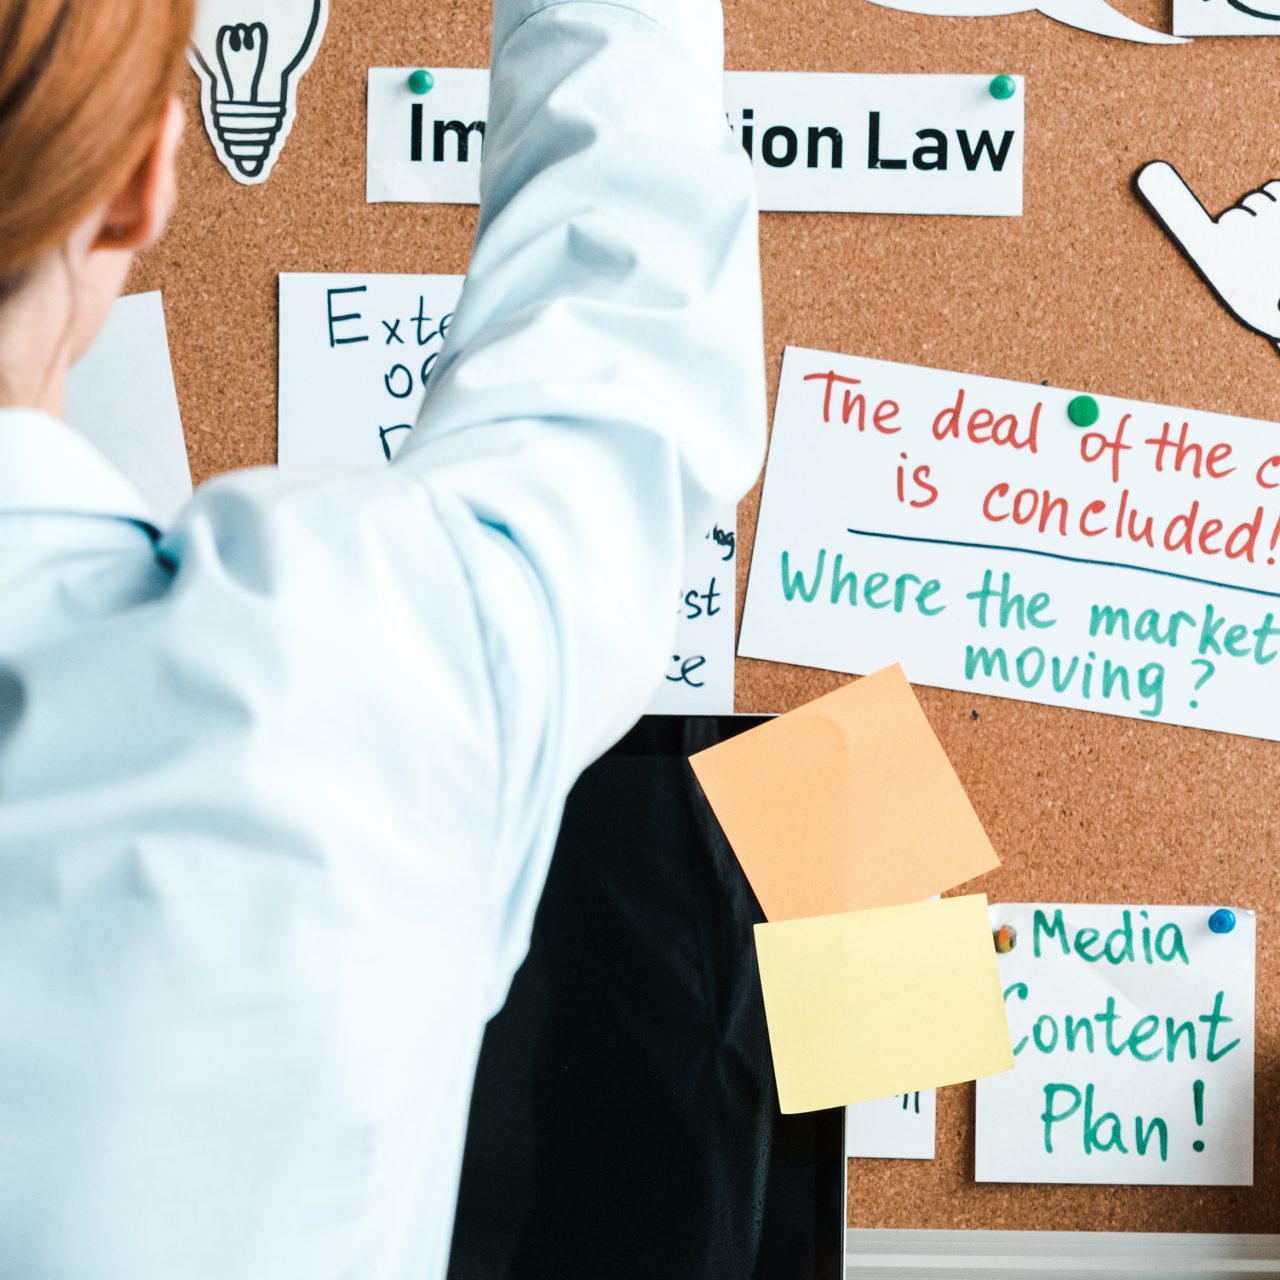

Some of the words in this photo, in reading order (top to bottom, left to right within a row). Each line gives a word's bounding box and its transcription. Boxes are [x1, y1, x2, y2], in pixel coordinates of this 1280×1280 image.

[868, 111, 1014, 171] Law
[932, 388, 1042, 454] deal
[1080, 413, 1133, 483] of
[1145, 422, 1235, 478] the
[897, 452, 938, 508] is
[982, 482, 1280, 566] concluded!
[781, 548, 947, 615] Where
[966, 569, 1056, 629] the
[1089, 604, 1280, 665] market
[1033, 908, 1189, 965] Media
